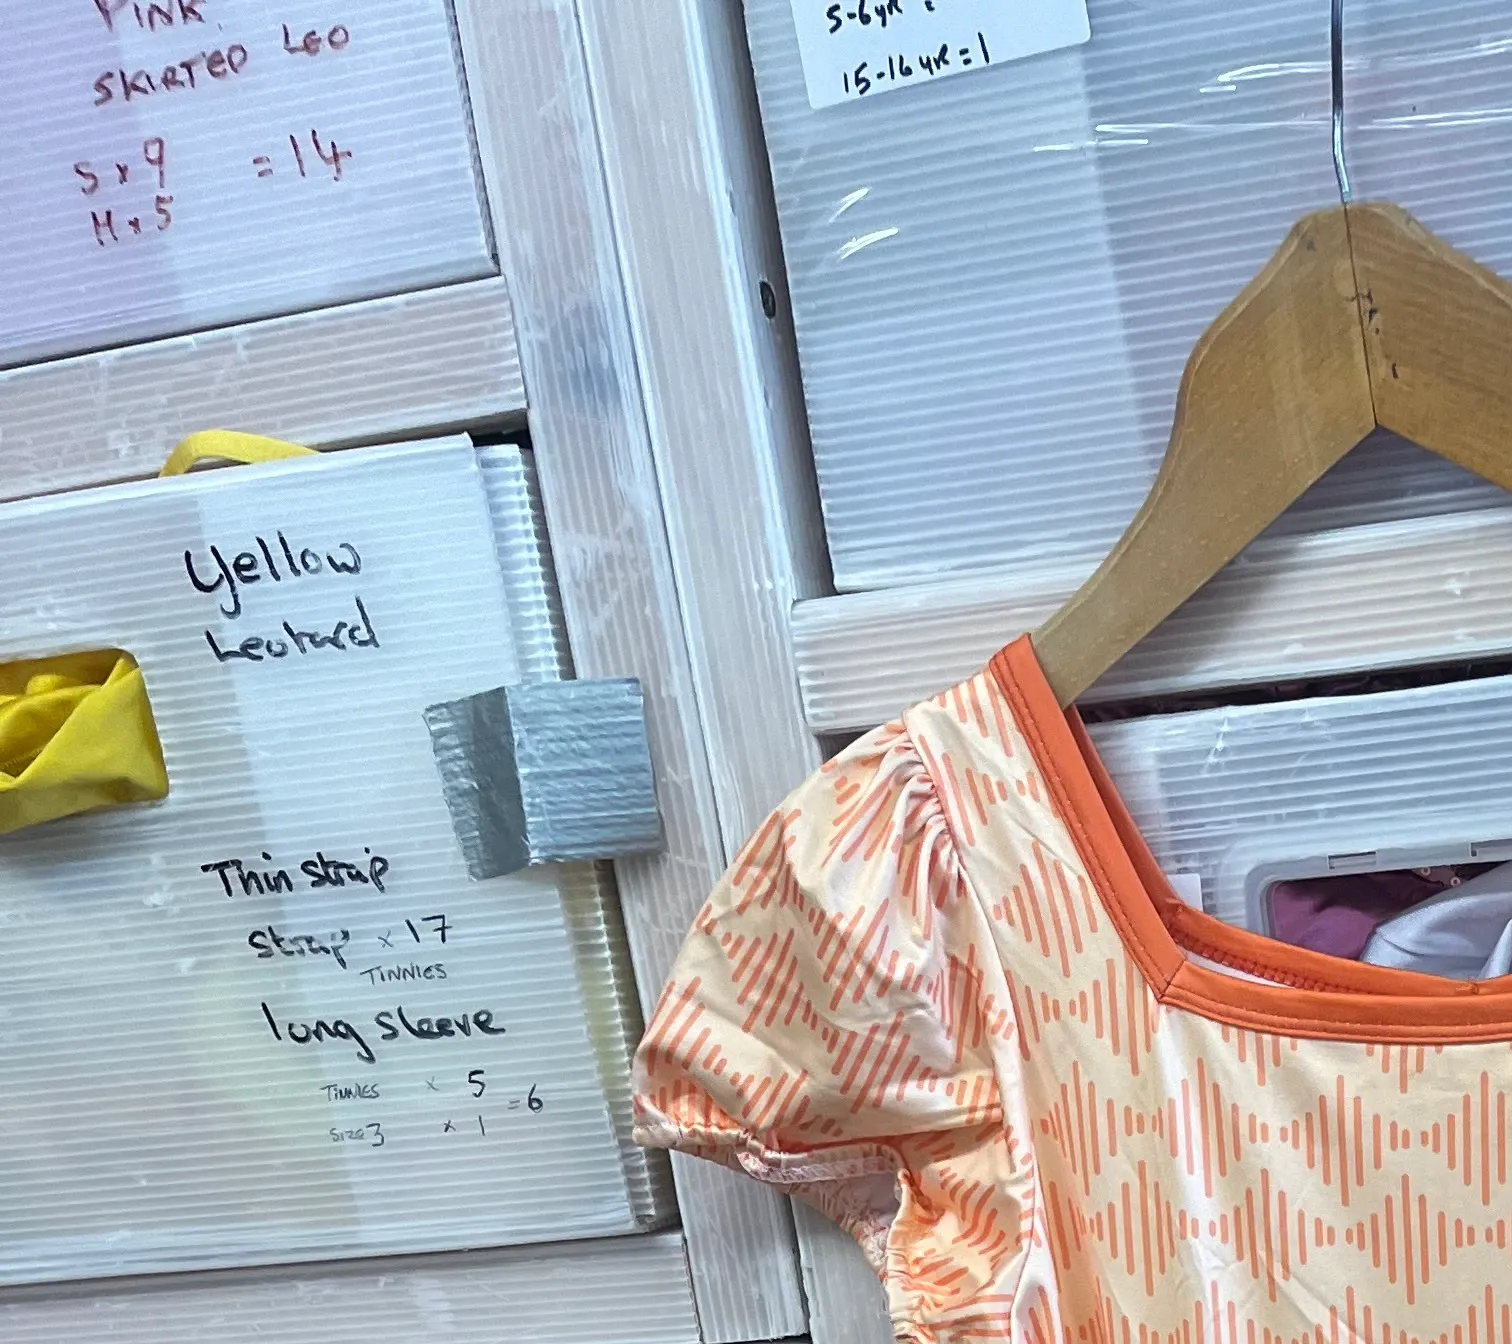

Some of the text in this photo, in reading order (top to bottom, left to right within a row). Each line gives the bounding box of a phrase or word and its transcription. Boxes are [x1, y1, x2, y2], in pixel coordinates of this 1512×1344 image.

[93, 23, 351, 107] SKIRTED LEO
[201, 851, 294, 898] Thin
[404, 913, 454, 945] 17
[260, 1002, 377, 1065] long
